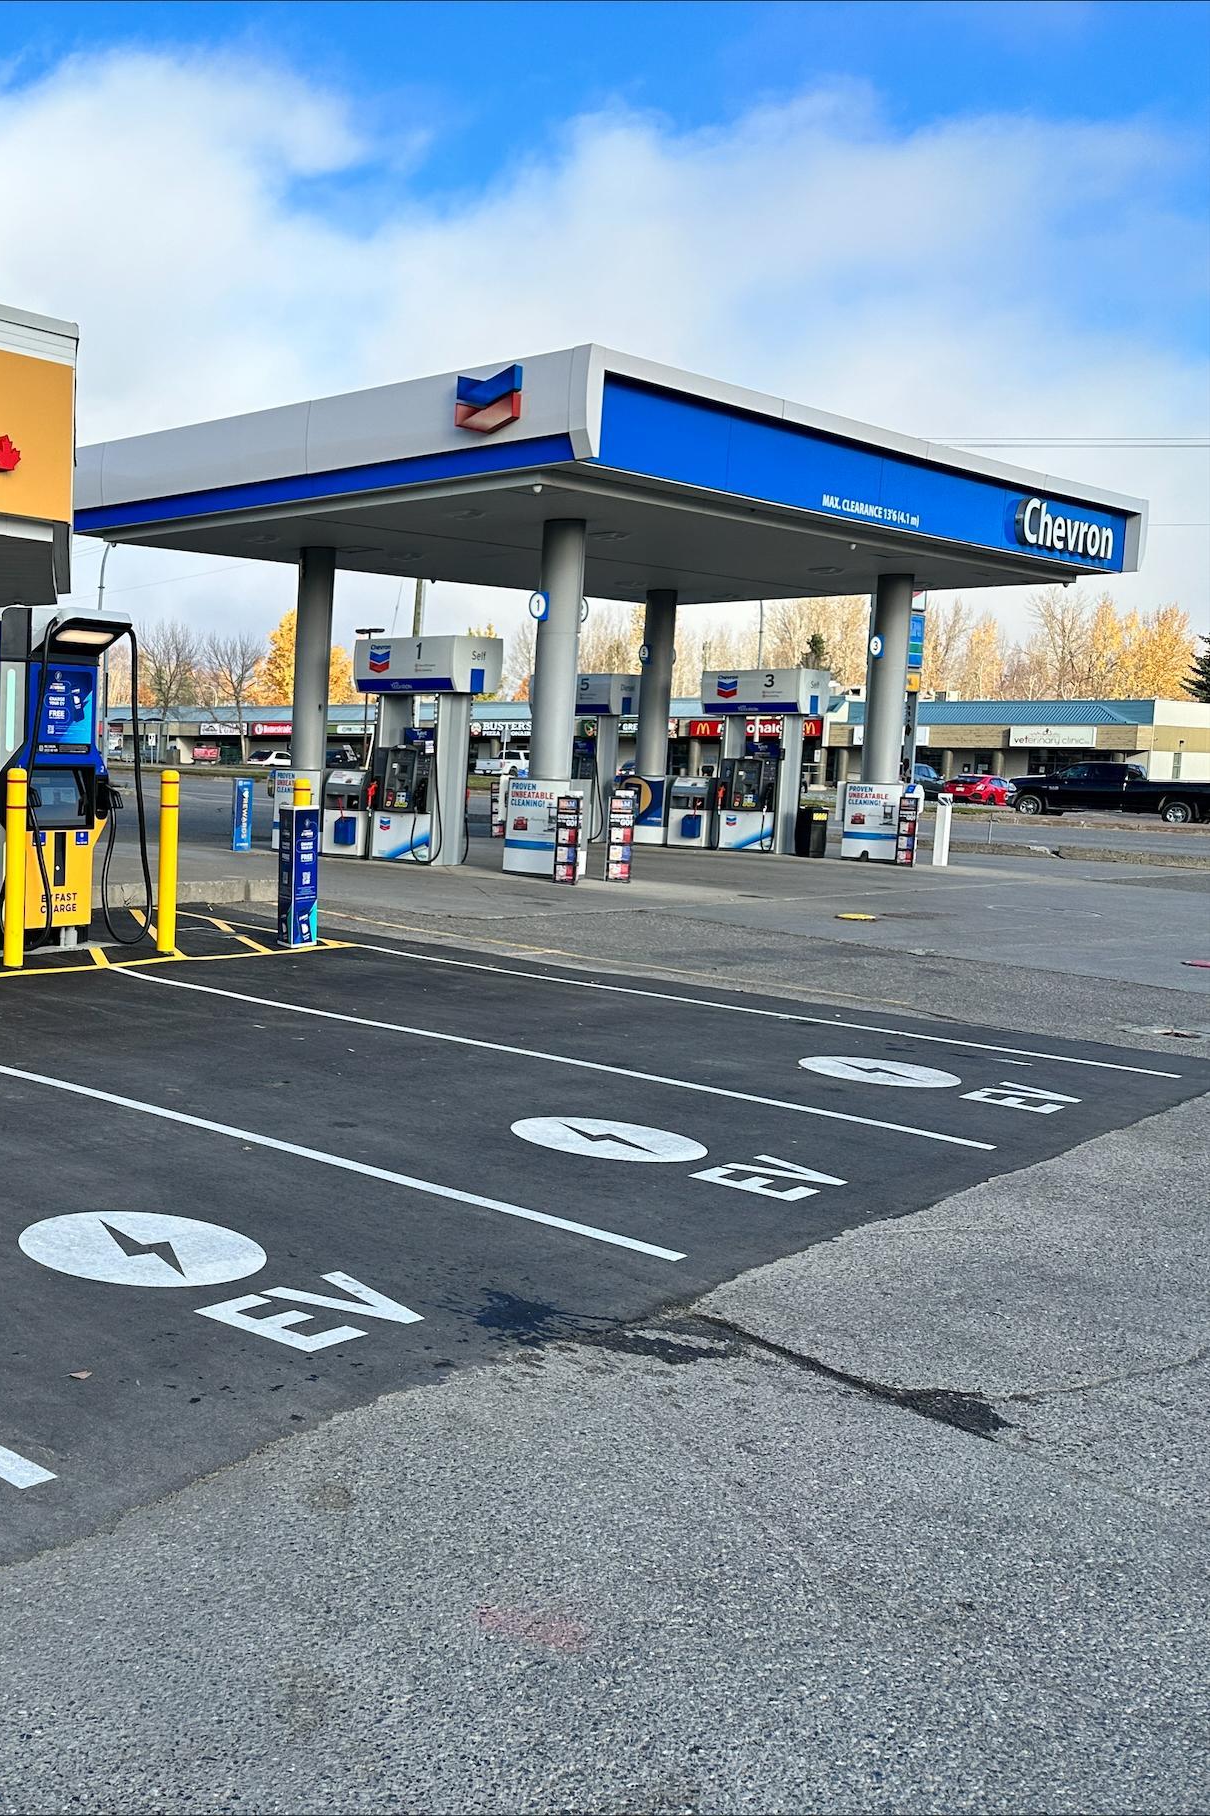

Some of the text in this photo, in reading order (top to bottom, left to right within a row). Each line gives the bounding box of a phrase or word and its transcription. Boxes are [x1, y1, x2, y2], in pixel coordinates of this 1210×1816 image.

[822, 494, 841, 510] MAX.
[842, 499, 883, 519] CLEARANCE
[1021, 496, 1114, 560] Chevron
[415, 642, 423, 660] 1
[471, 650, 487, 661] Self
[580, 678, 590, 691] 5
[763, 673, 775, 688] 3
[1013, 735, 1085, 746] veterinary clinic
[512, 782, 537, 790] PROVEN
[511, 791, 554, 800] UNBEATABLE
[510, 799, 545, 808] CLEANING!
[55, 893, 77, 901] FAST
[40, 904, 77, 914] CARGE
[959, 1079, 1084, 1115] EV
[688, 1153, 848, 1202] EV
[195, 1270, 425, 1353] EV
